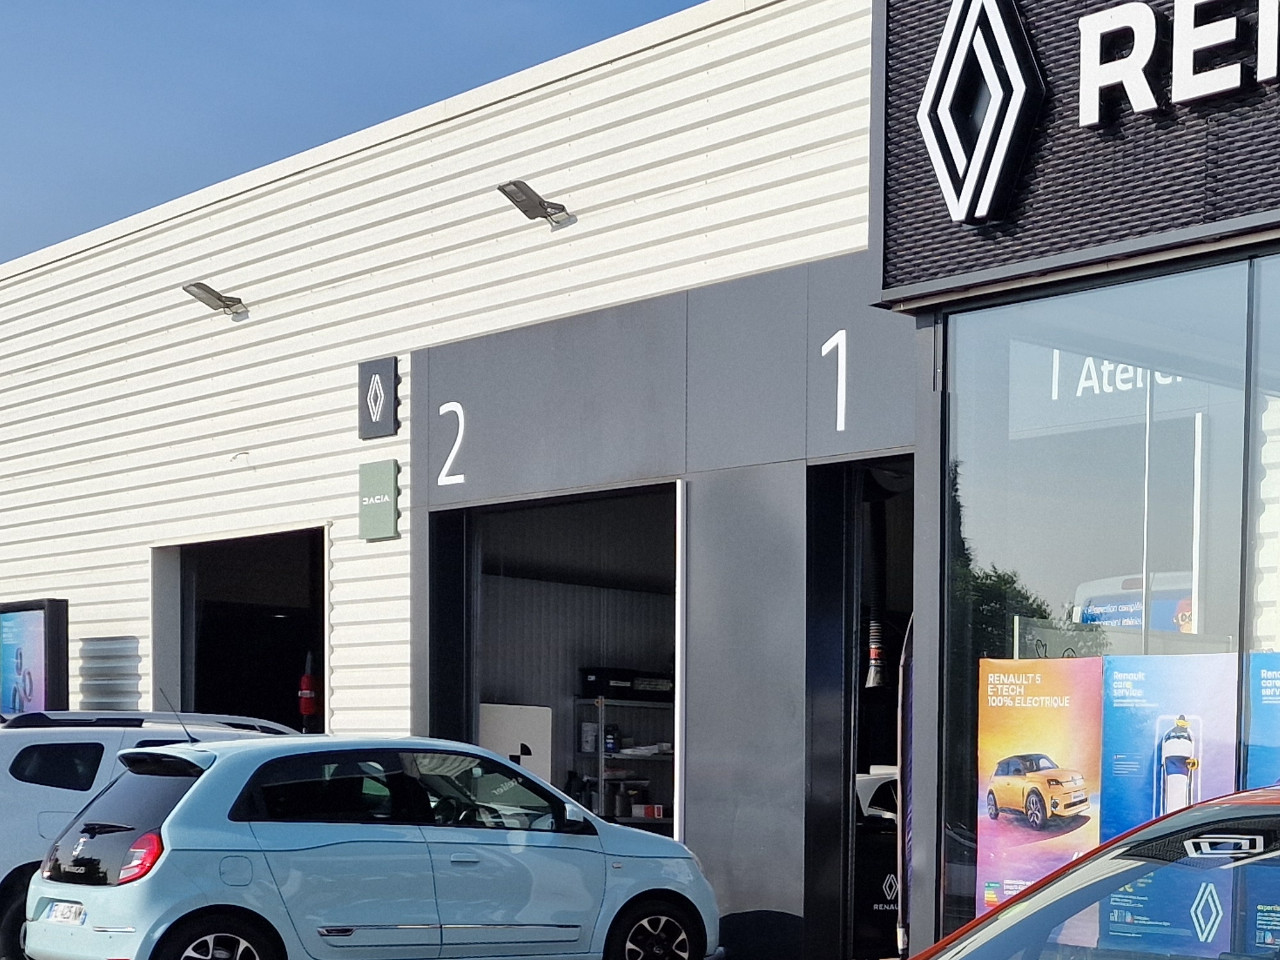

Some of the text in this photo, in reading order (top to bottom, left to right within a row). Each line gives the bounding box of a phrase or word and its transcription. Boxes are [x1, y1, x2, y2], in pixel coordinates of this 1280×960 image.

[820, 328, 847, 432] 1
[437, 401, 465, 486] 2
[362, 494, 390, 505] DACIA
[987, 673, 1042, 684] RENAULT 5
[987, 685, 1024, 695] E-TECH
[987, 696, 1013, 707] 100%
